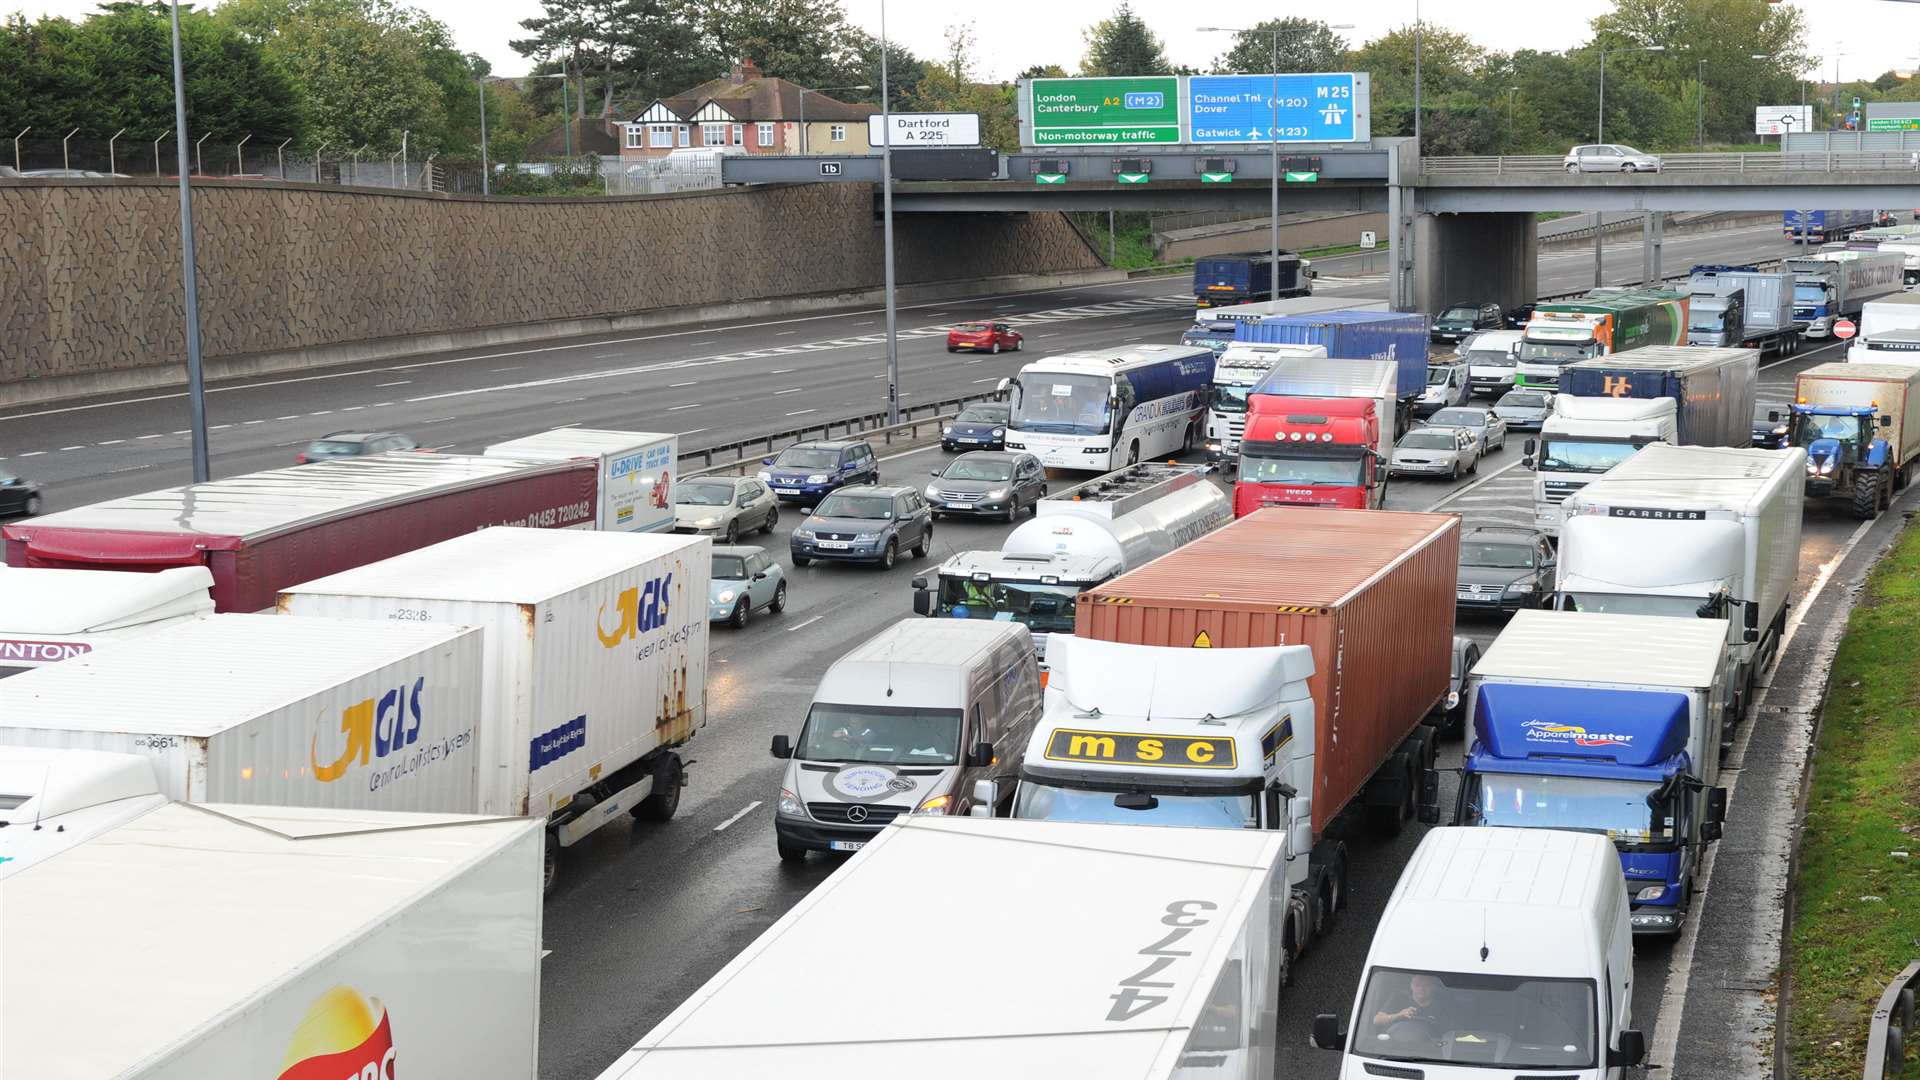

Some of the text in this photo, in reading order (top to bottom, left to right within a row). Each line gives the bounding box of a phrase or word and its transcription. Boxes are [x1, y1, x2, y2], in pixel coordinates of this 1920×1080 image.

[1037, 94, 1076, 103] London
[1195, 93, 1262, 104] Channel Tnl
[1037, 104, 1099, 114] Canterbury
[1194, 104, 1228, 114] Dover
[898, 119, 950, 129] Dartford
[1039, 130, 1157, 142] Non-motorway traffic
[1196, 128, 1242, 138] Gatwick
[825, 164, 838, 174] 1b
[1286, 488, 1313, 496] IVECO
[528, 508, 556, 528] 01452
[557, 501, 591, 524] 720242
[1616, 508, 1698, 520] CARRIER
[637, 572, 672, 634] GLS
[0, 642, 84, 660] NTON
[375, 676, 425, 758] GLS
[1526, 728, 1634, 741] Apparelmaster
